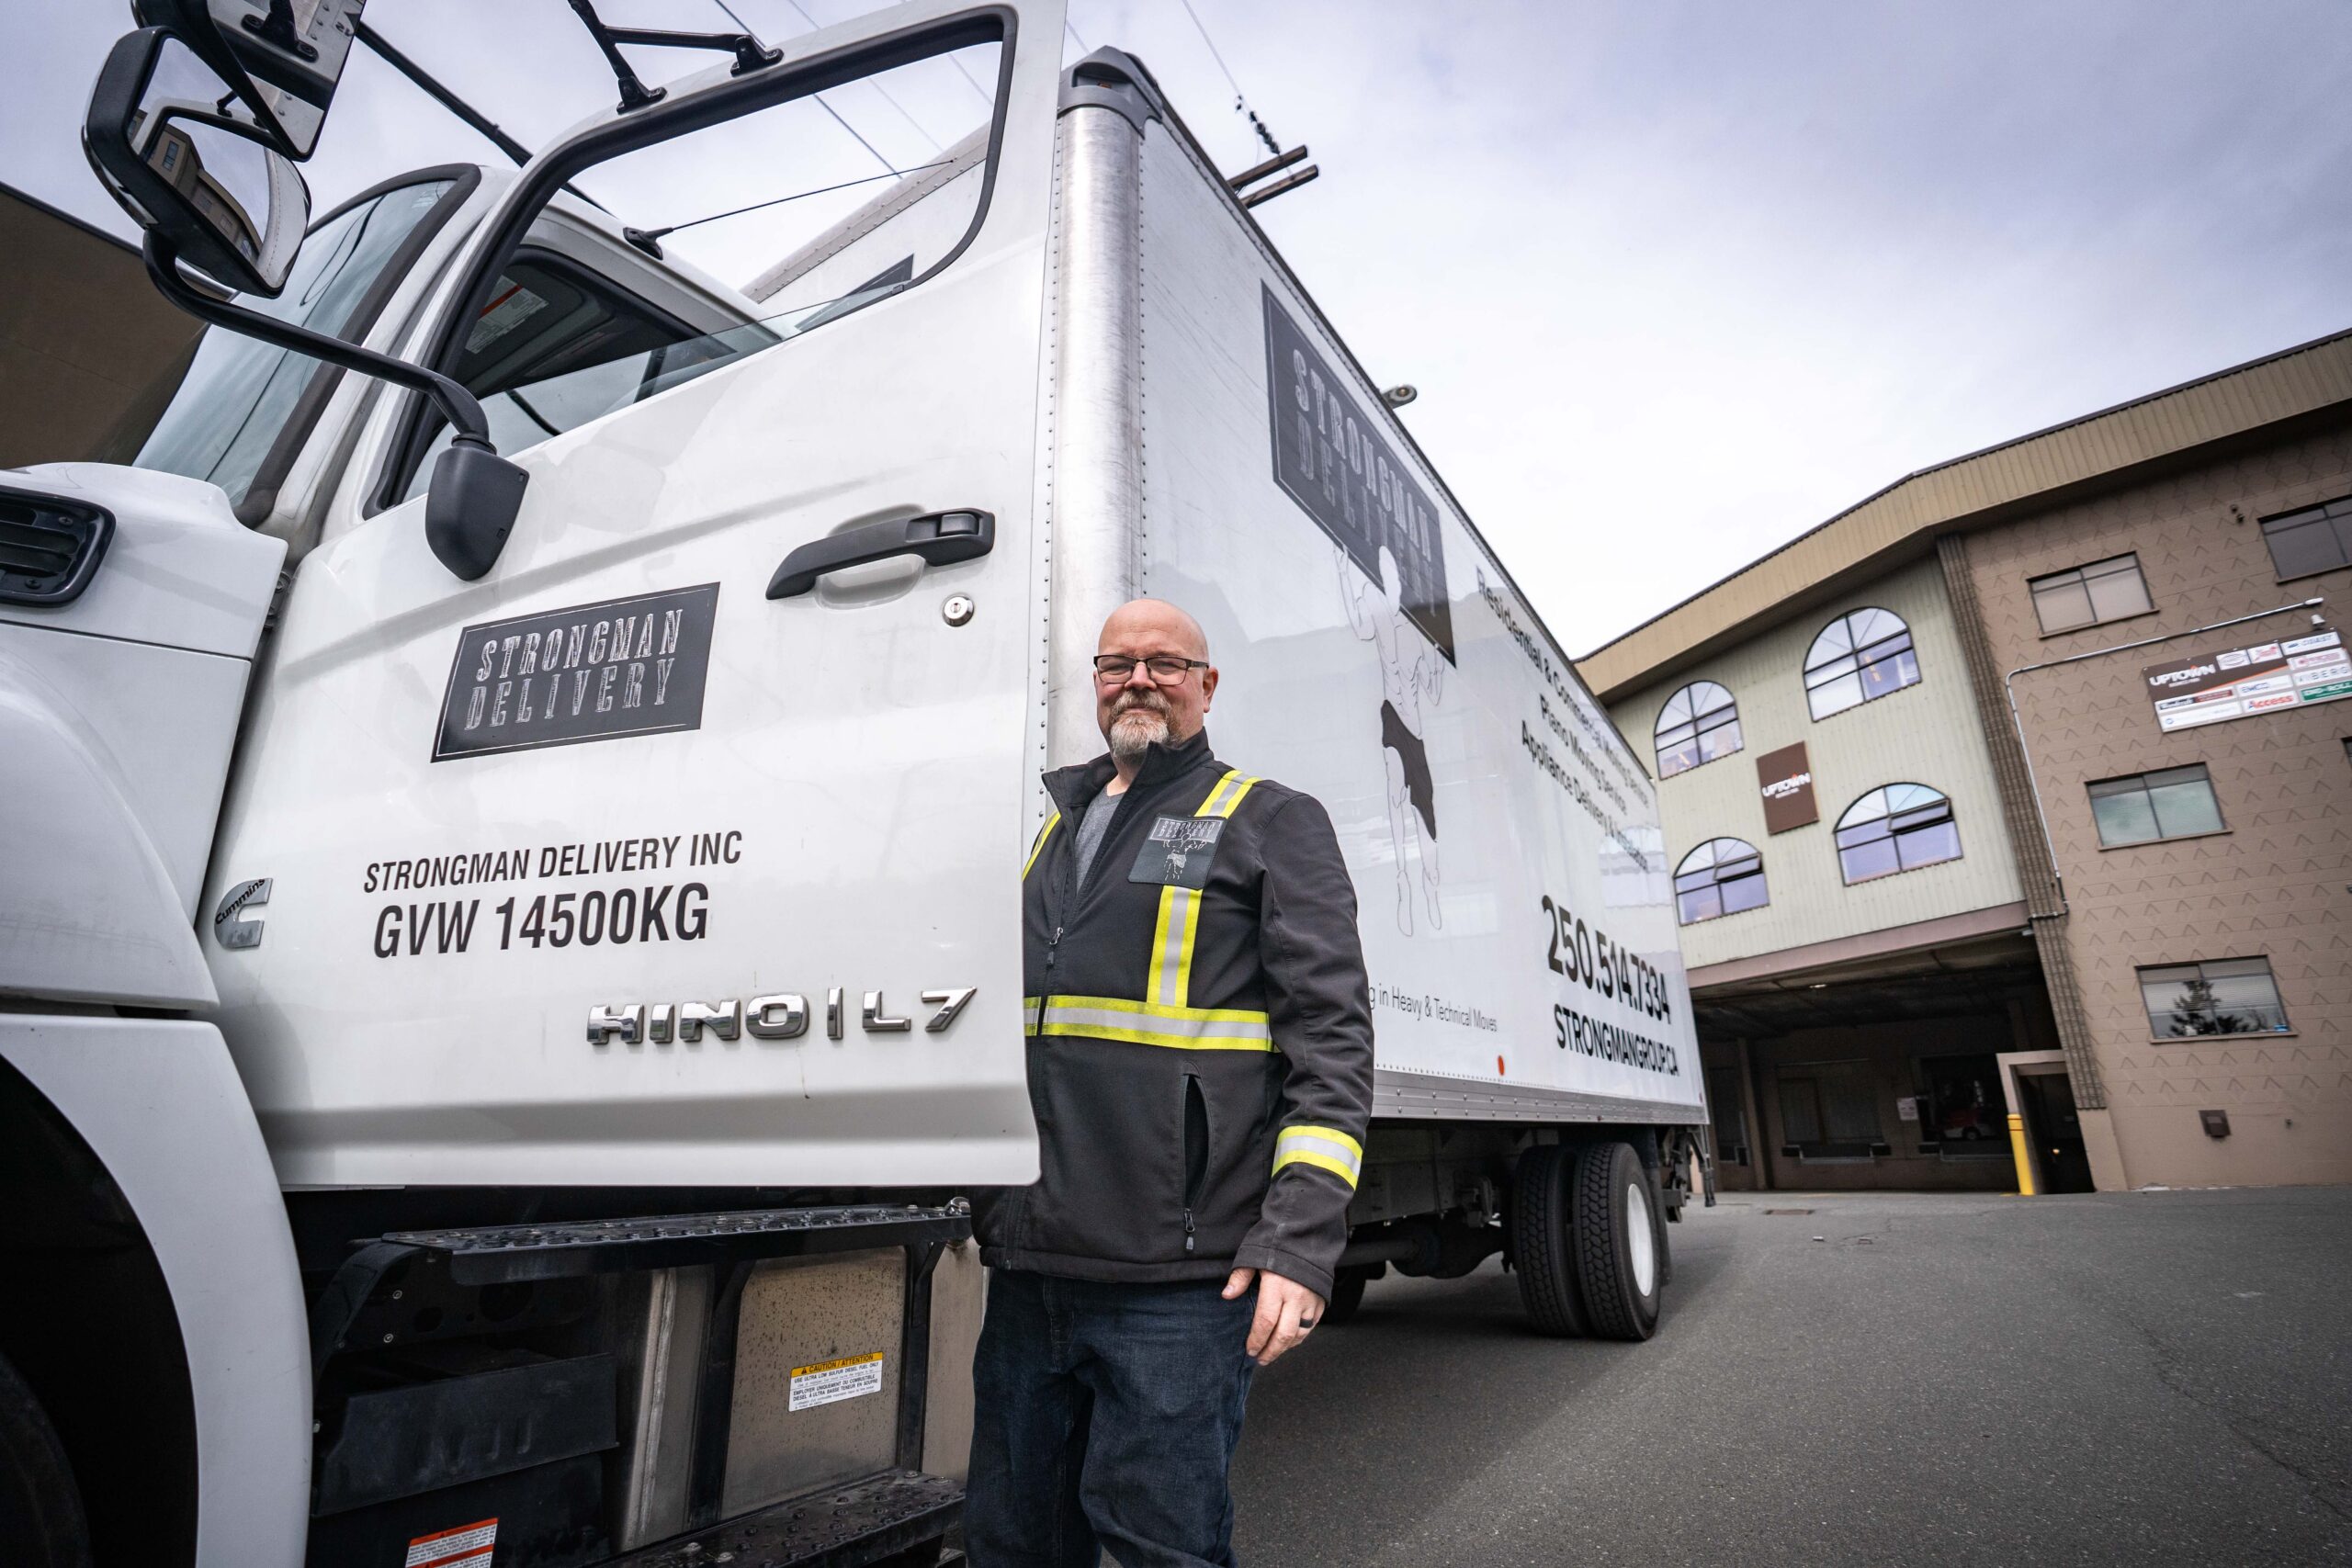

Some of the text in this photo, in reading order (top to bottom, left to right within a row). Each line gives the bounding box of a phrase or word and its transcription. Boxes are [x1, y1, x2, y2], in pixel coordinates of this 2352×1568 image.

[1293, 348, 1432, 563] STRONGMAN
[476, 608, 684, 682] STRONGMAN
[1476, 565, 1544, 673] Residential
[1544, 658, 1554, 686] &
[464, 658, 675, 731] DELIVERY
[2149, 663, 2217, 687] UPTOWN
[2248, 694, 2294, 713] Access
[1540, 693, 1569, 748] Piano
[1521, 719, 1574, 796] Appliance
[364, 830, 742, 894] STRONGMAN DELIVERY INC
[215, 878, 266, 925] Cummins
[374, 882, 709, 959] GVW 14500KG
[1541, 895, 1672, 1025] 250.514.7334
[586, 991, 809, 1045] HINO
[1379, 983, 1389, 1008] in
[1392, 986, 1423, 1021] Heavy
[1425, 995, 1432, 1017] &
[1433, 998, 1473, 1027] Technical
[1473, 1008, 1498, 1032] Moves
[794, 1387, 815, 1395] EMPLOYER
[809, 1360, 836, 1373] CAUTION
[842, 1355, 874, 1367] ATTENTION
